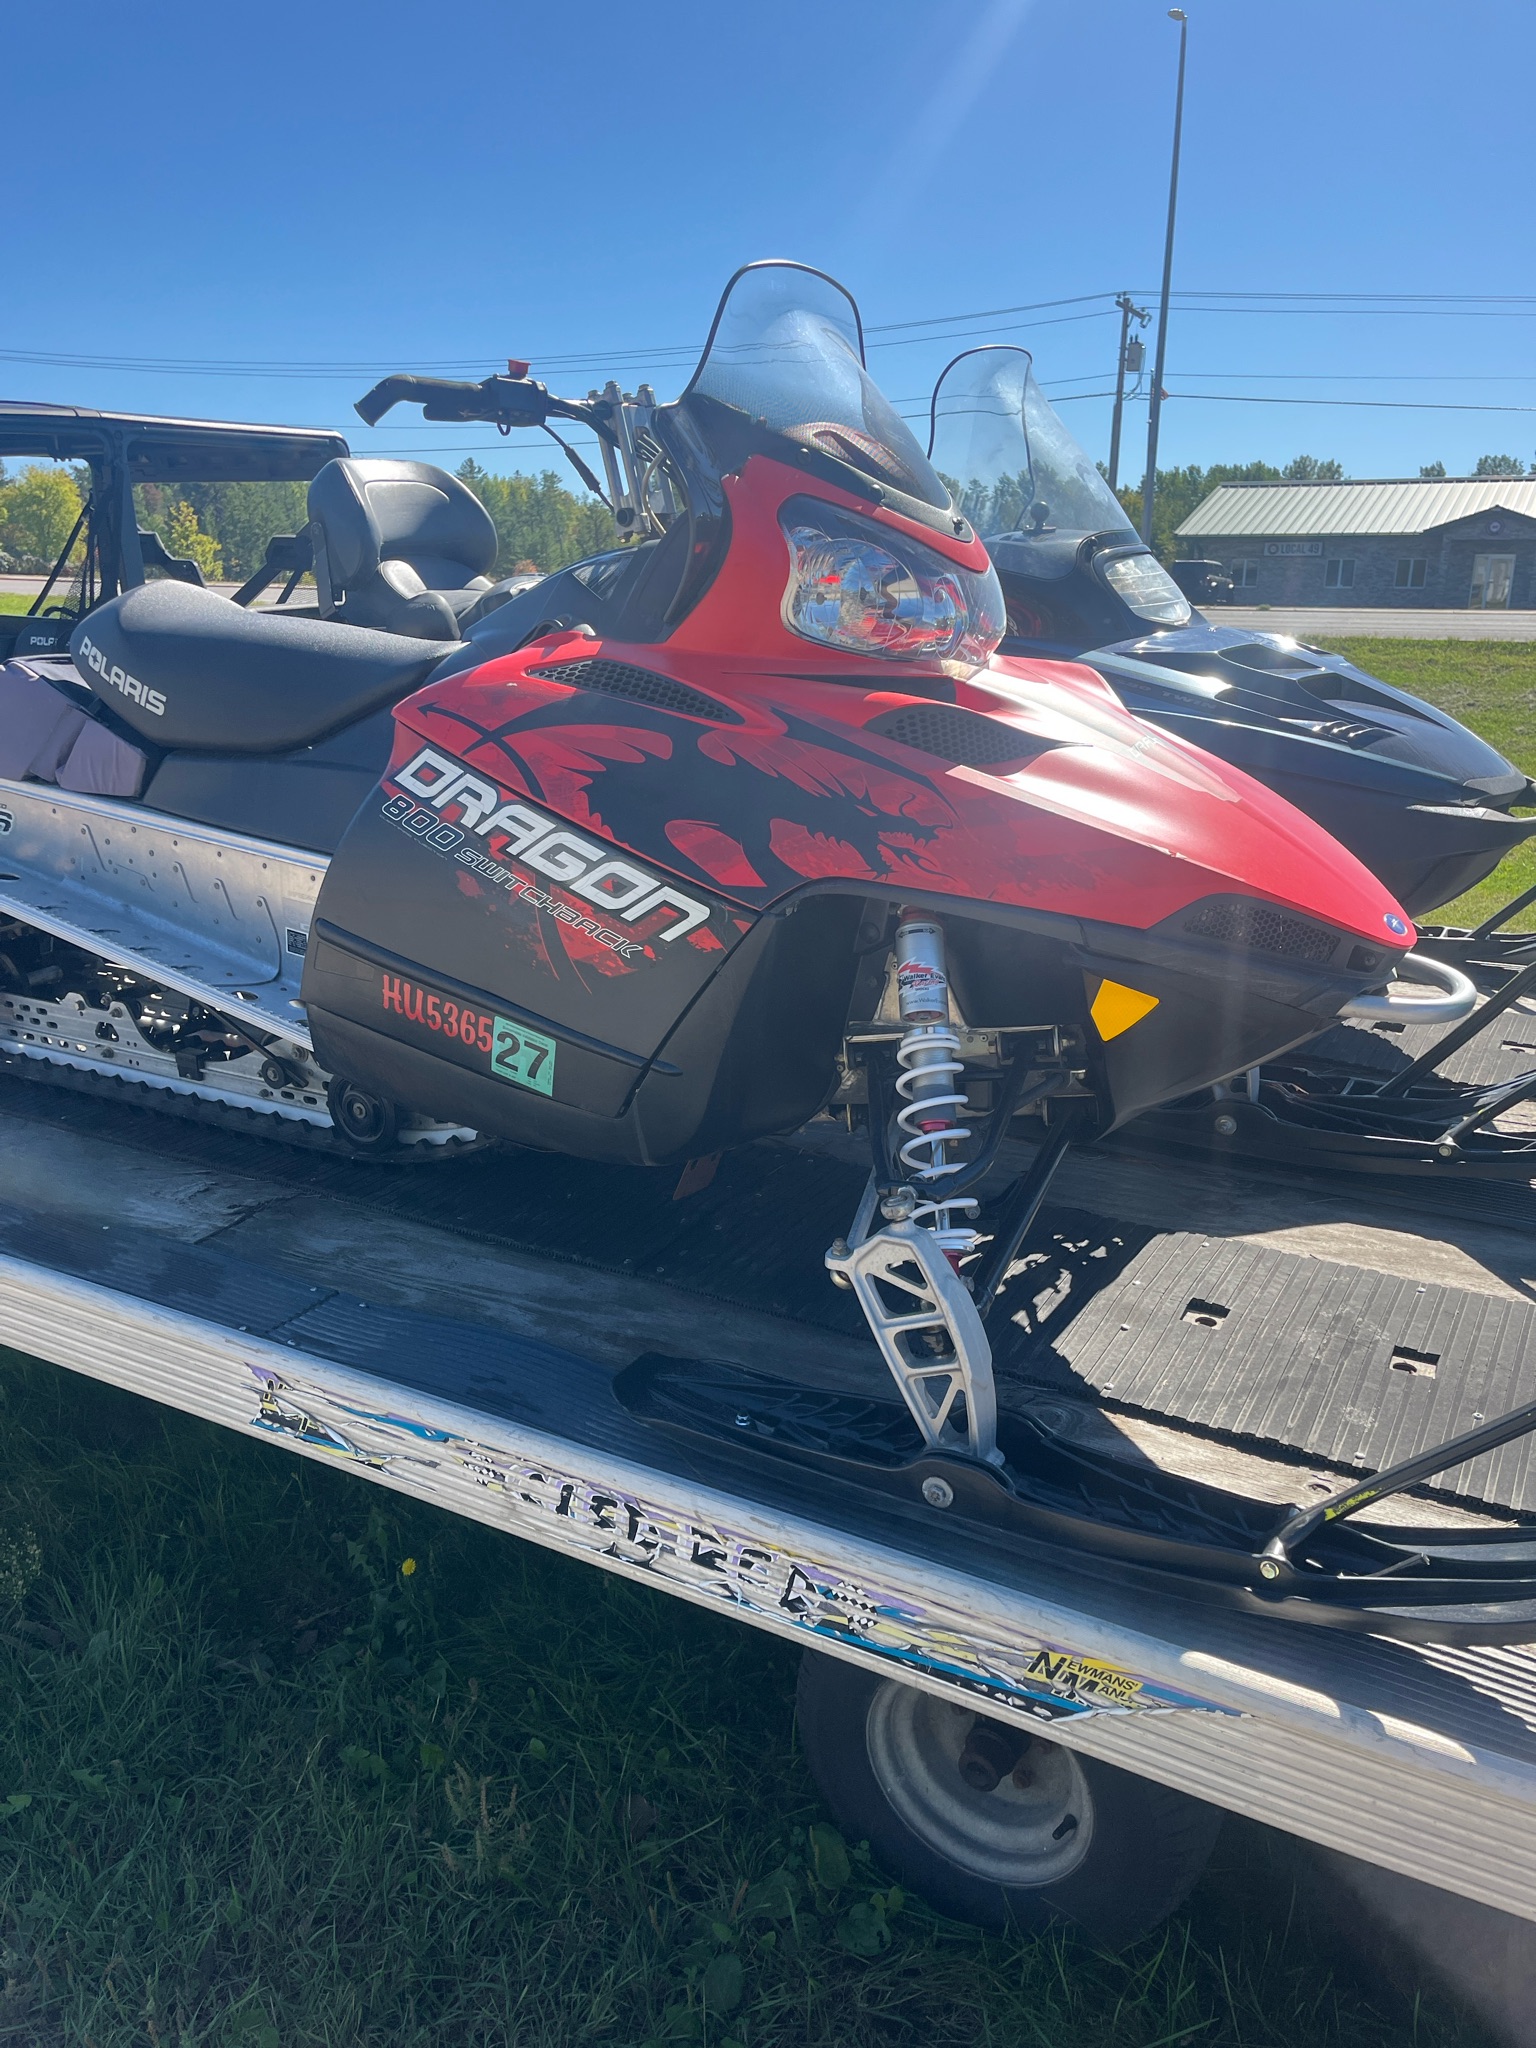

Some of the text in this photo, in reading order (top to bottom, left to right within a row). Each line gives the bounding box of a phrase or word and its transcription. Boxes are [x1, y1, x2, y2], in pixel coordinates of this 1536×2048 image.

[1281, 543, 1320, 554] LOCAL 49
[79, 635, 167, 716] POLARIS
[381, 794, 644, 958] 800 SWITCHBACK
[394, 748, 711, 942] DRAGON
[382, 974, 493, 1053] HU5365
[496, 1031, 549, 1080] 27
